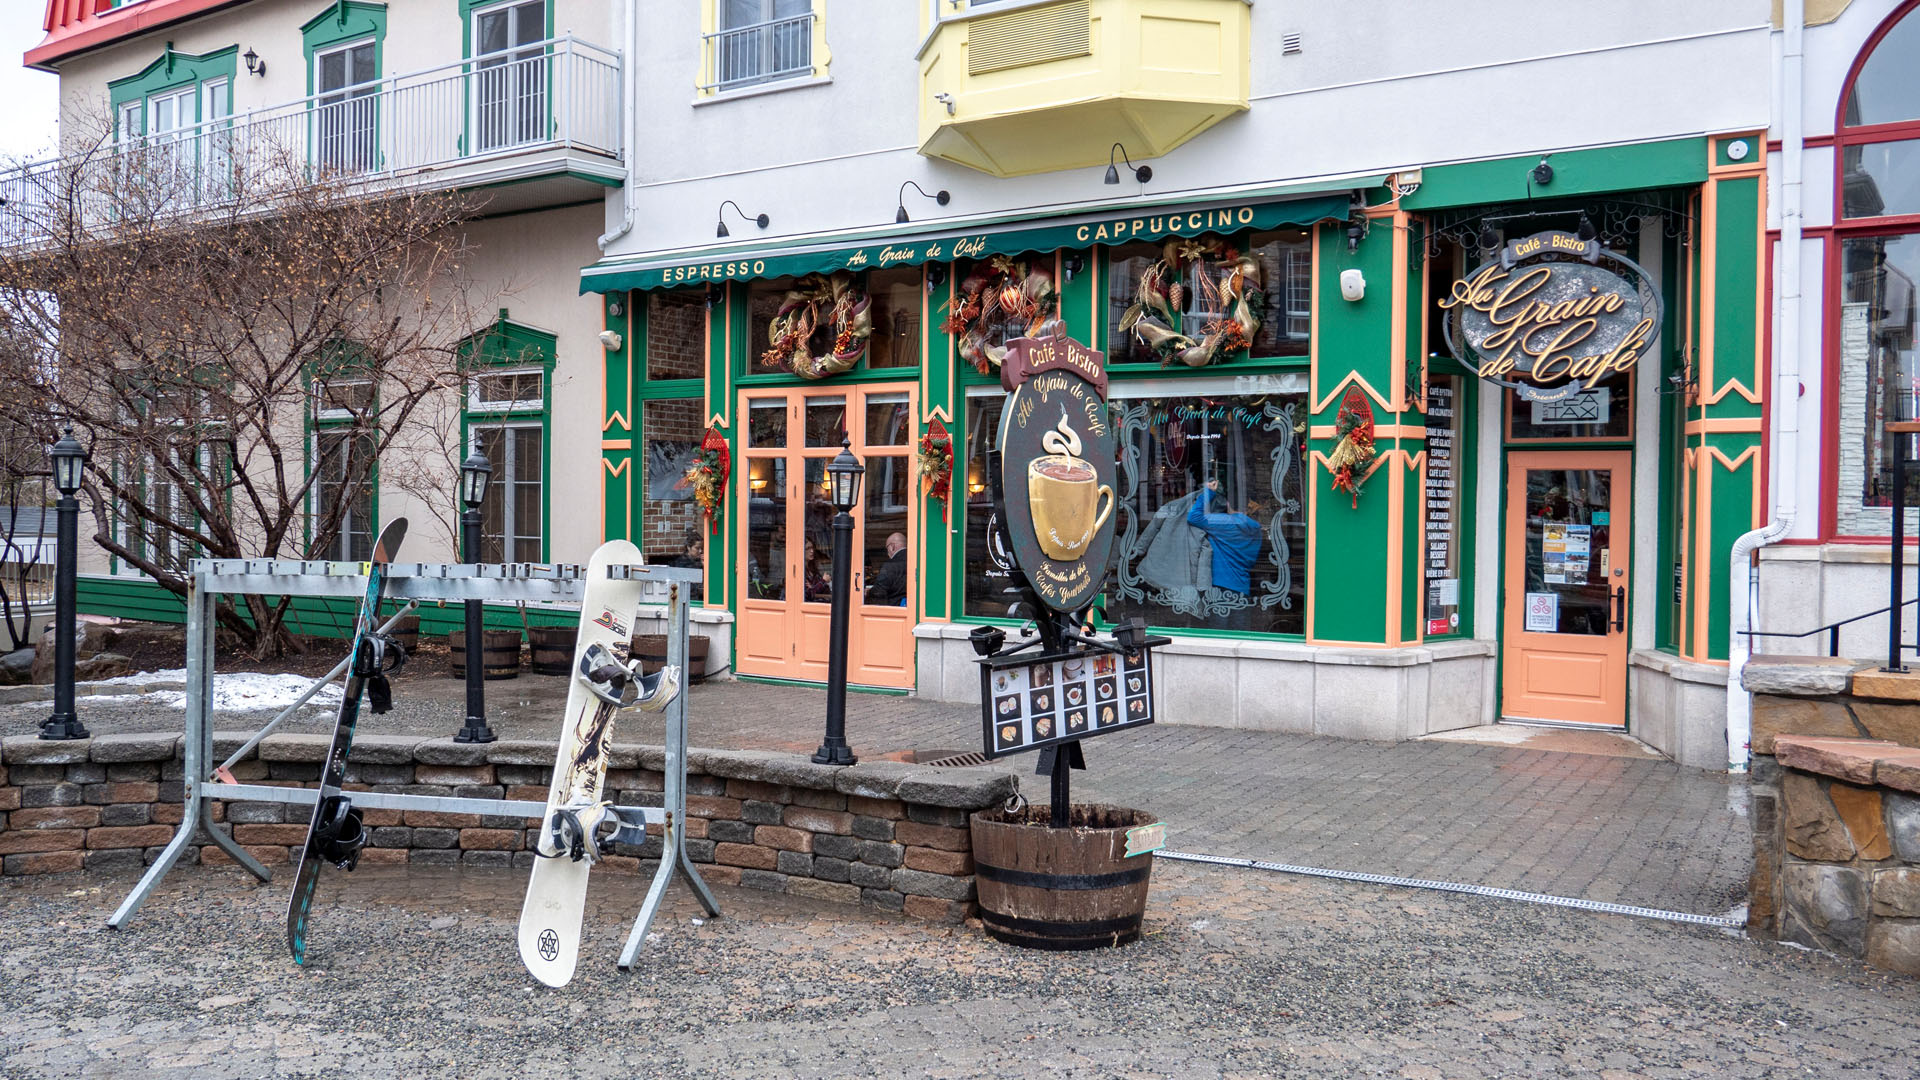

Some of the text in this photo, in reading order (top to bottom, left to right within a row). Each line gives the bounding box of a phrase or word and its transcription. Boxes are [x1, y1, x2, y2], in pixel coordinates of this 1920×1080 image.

[1076, 206, 1255, 241] CAPPUCCINO
[846, 235, 986, 268] Au Grain de Café
[1515, 237, 1541, 256] Café
[1552, 234, 1586, 252] Bistro
[662, 260, 765, 282] ESPRESSO
[1438, 265, 1624, 349] Au Grain
[1029, 341, 1056, 367] Café
[1067, 344, 1101, 378] Bistro
[1479, 316, 1653, 389] de Café
[1016, 371, 1107, 438] Au Grain de Café
[1526, 388, 1568, 400] Internet
